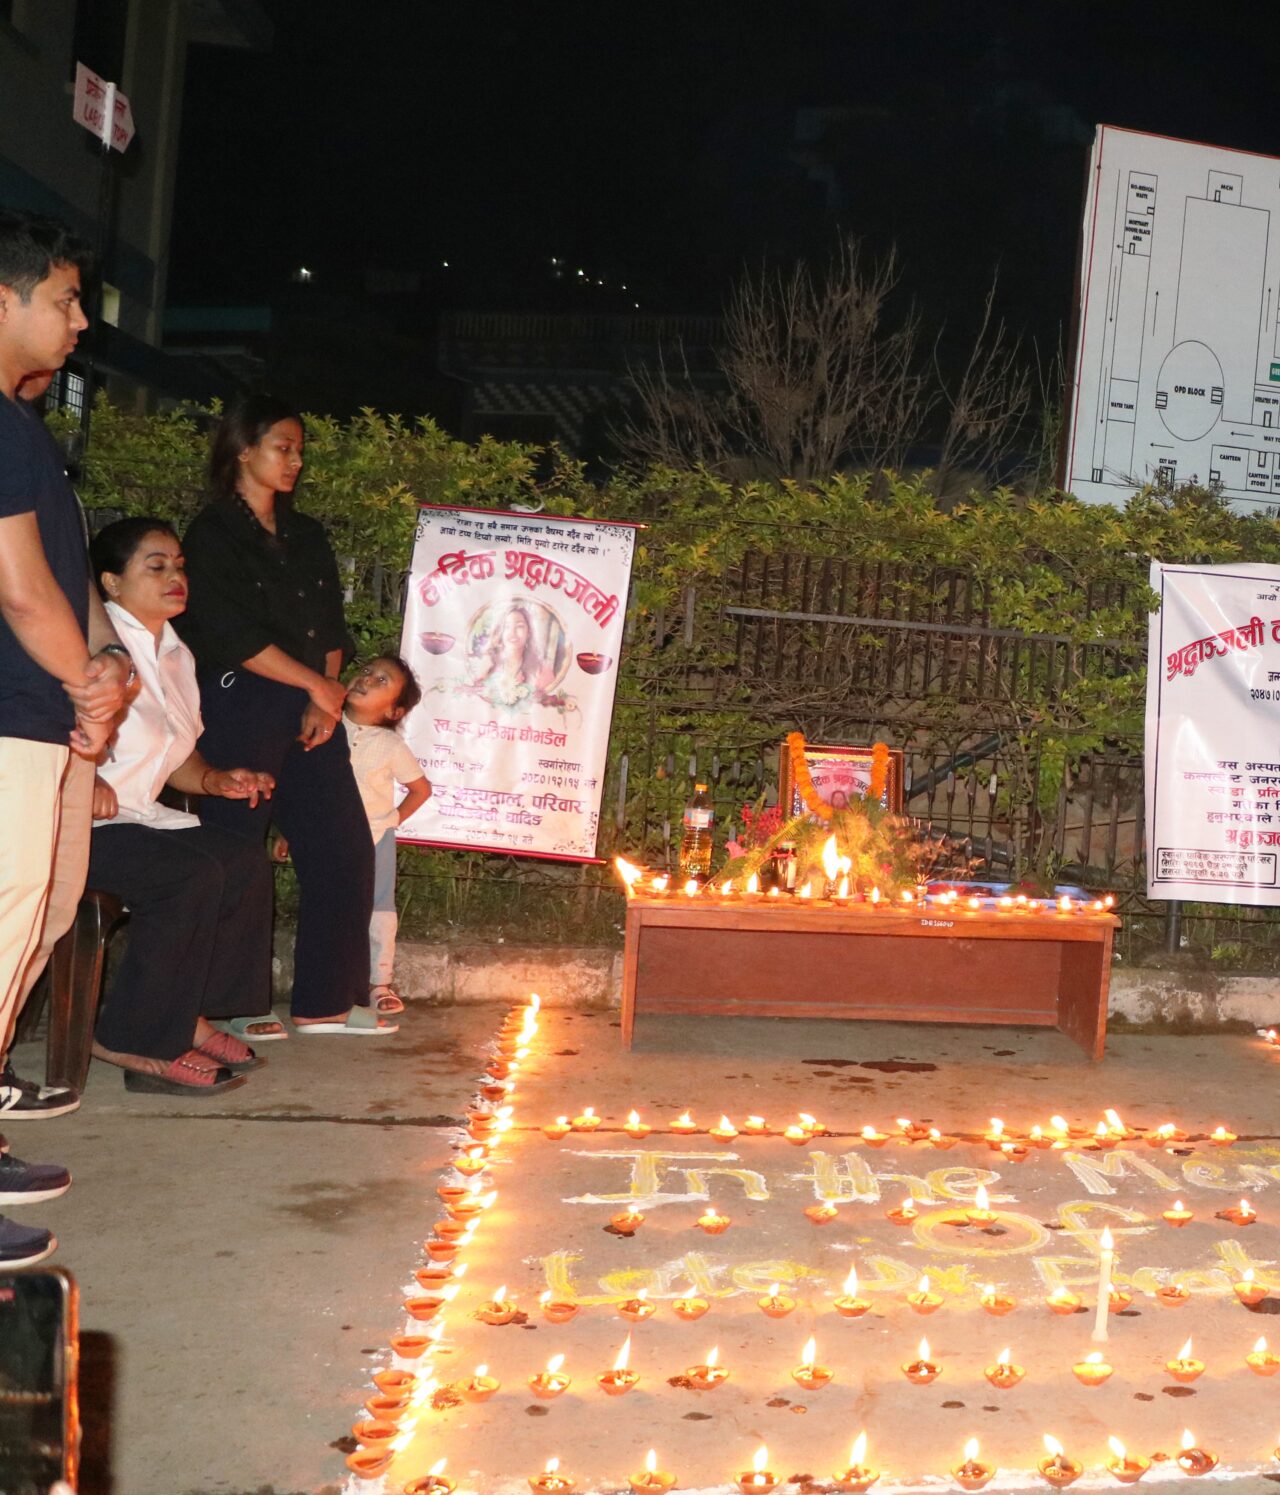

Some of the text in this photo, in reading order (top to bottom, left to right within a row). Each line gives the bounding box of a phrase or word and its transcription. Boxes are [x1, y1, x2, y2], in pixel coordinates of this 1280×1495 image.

[1174, 385, 1205, 397] OPD BLOCK
[1111, 401, 1123, 409] WATER
[1220, 454, 1241, 462] CANTEEN
[1248, 472, 1270, 480] CANTEEN
[516, 535, 532, 545] मिति
[417, 550, 619, 629] हार्दिक श्रद्धाञ्जली
[1217, 761, 1239, 770] यस
[532, 793, 585, 814] परिवार
[560, 1147, 770, 1203] In
[784, 1149, 1018, 1205] the
[541, 1250, 814, 1304] Late
